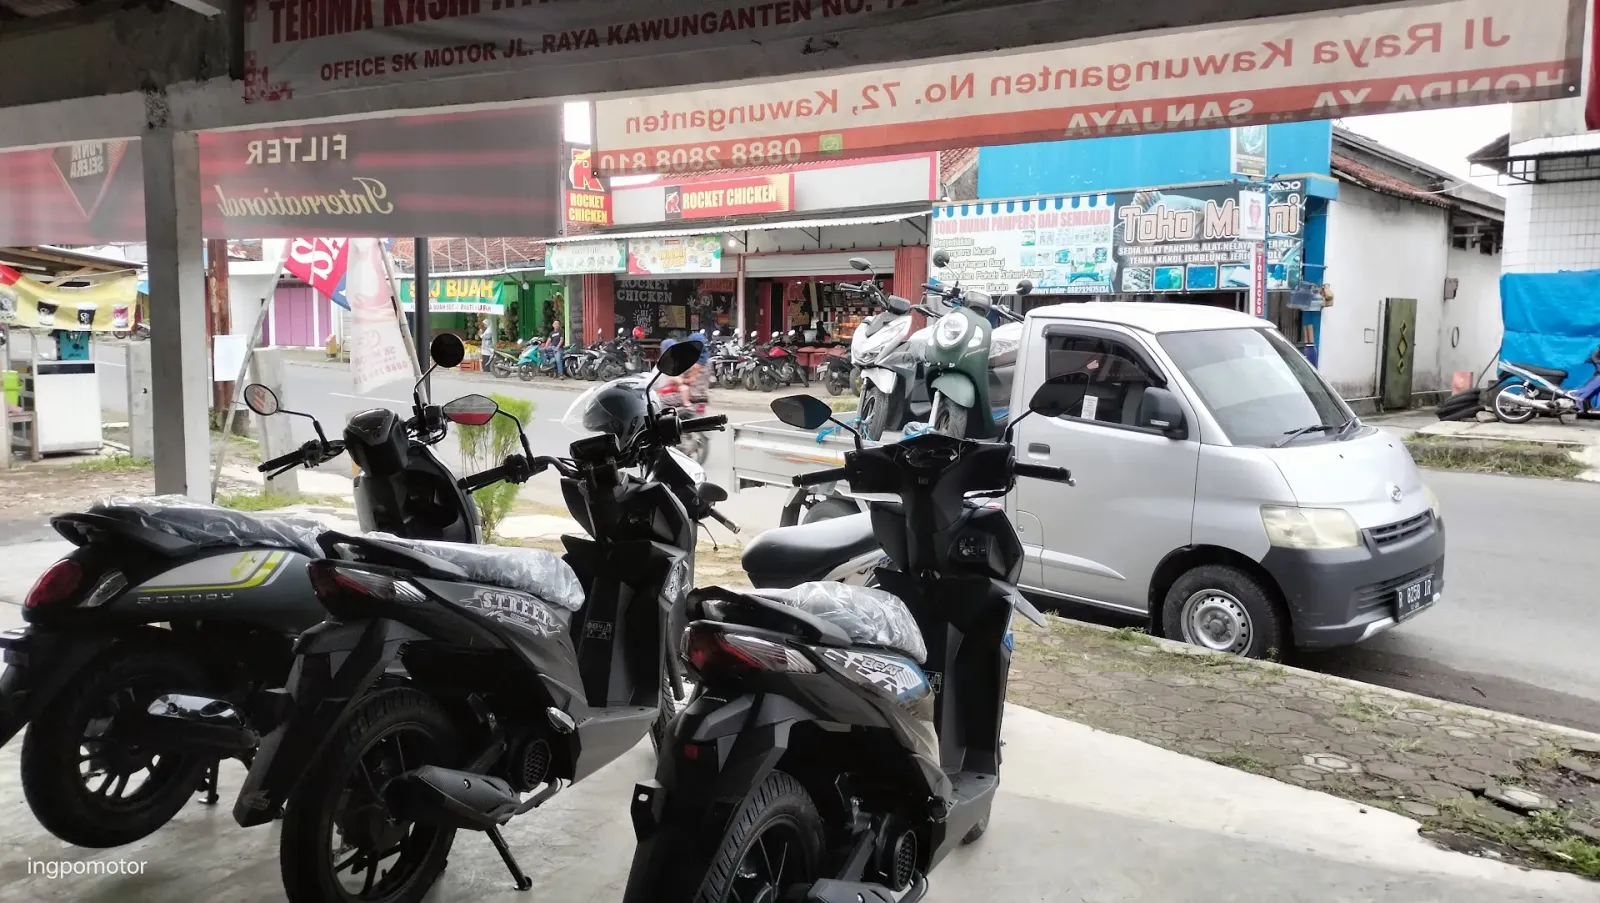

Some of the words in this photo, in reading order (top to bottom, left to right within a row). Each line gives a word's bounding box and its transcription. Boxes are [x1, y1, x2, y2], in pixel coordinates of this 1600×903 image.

[270, 0, 374, 44] TERIMA
[320, 56, 386, 82] OFFICE
[391, 51, 418, 73] SK
[424, 42, 497, 69] MOTOR
[503, 38, 533, 59] JL.
[541, 29, 599, 54] RAYA
[607, 0, 811, 47] KAWUNGANTEN
[570, 192, 605, 209] ROCKET
[682, 188, 725, 210] ROCKET
[726, 184, 777, 206] CHICKEN
[568, 207, 608, 224] CHICKEN
[934, 219, 957, 235] TOKO
[959, 216, 990, 234] MURNI
[991, 213, 1036, 231] PAMPERS
[1037, 212, 1059, 229] DAN
[1060, 209, 1111, 227] SEMBAKO
[1118, 204, 1196, 243] Toko
[1203, 193, 1301, 238] Mni
[1144, 245, 1163, 254] ALAT
[1223, 240, 1254, 250] NELAYA
[1268, 239, 1295, 249] ERPAL,
[446, 279, 494, 299] BUAH
[616, 289, 673, 303] CHICKEN
[620, 279, 670, 290] ROCKET
[482, 591, 550, 626] STREET
